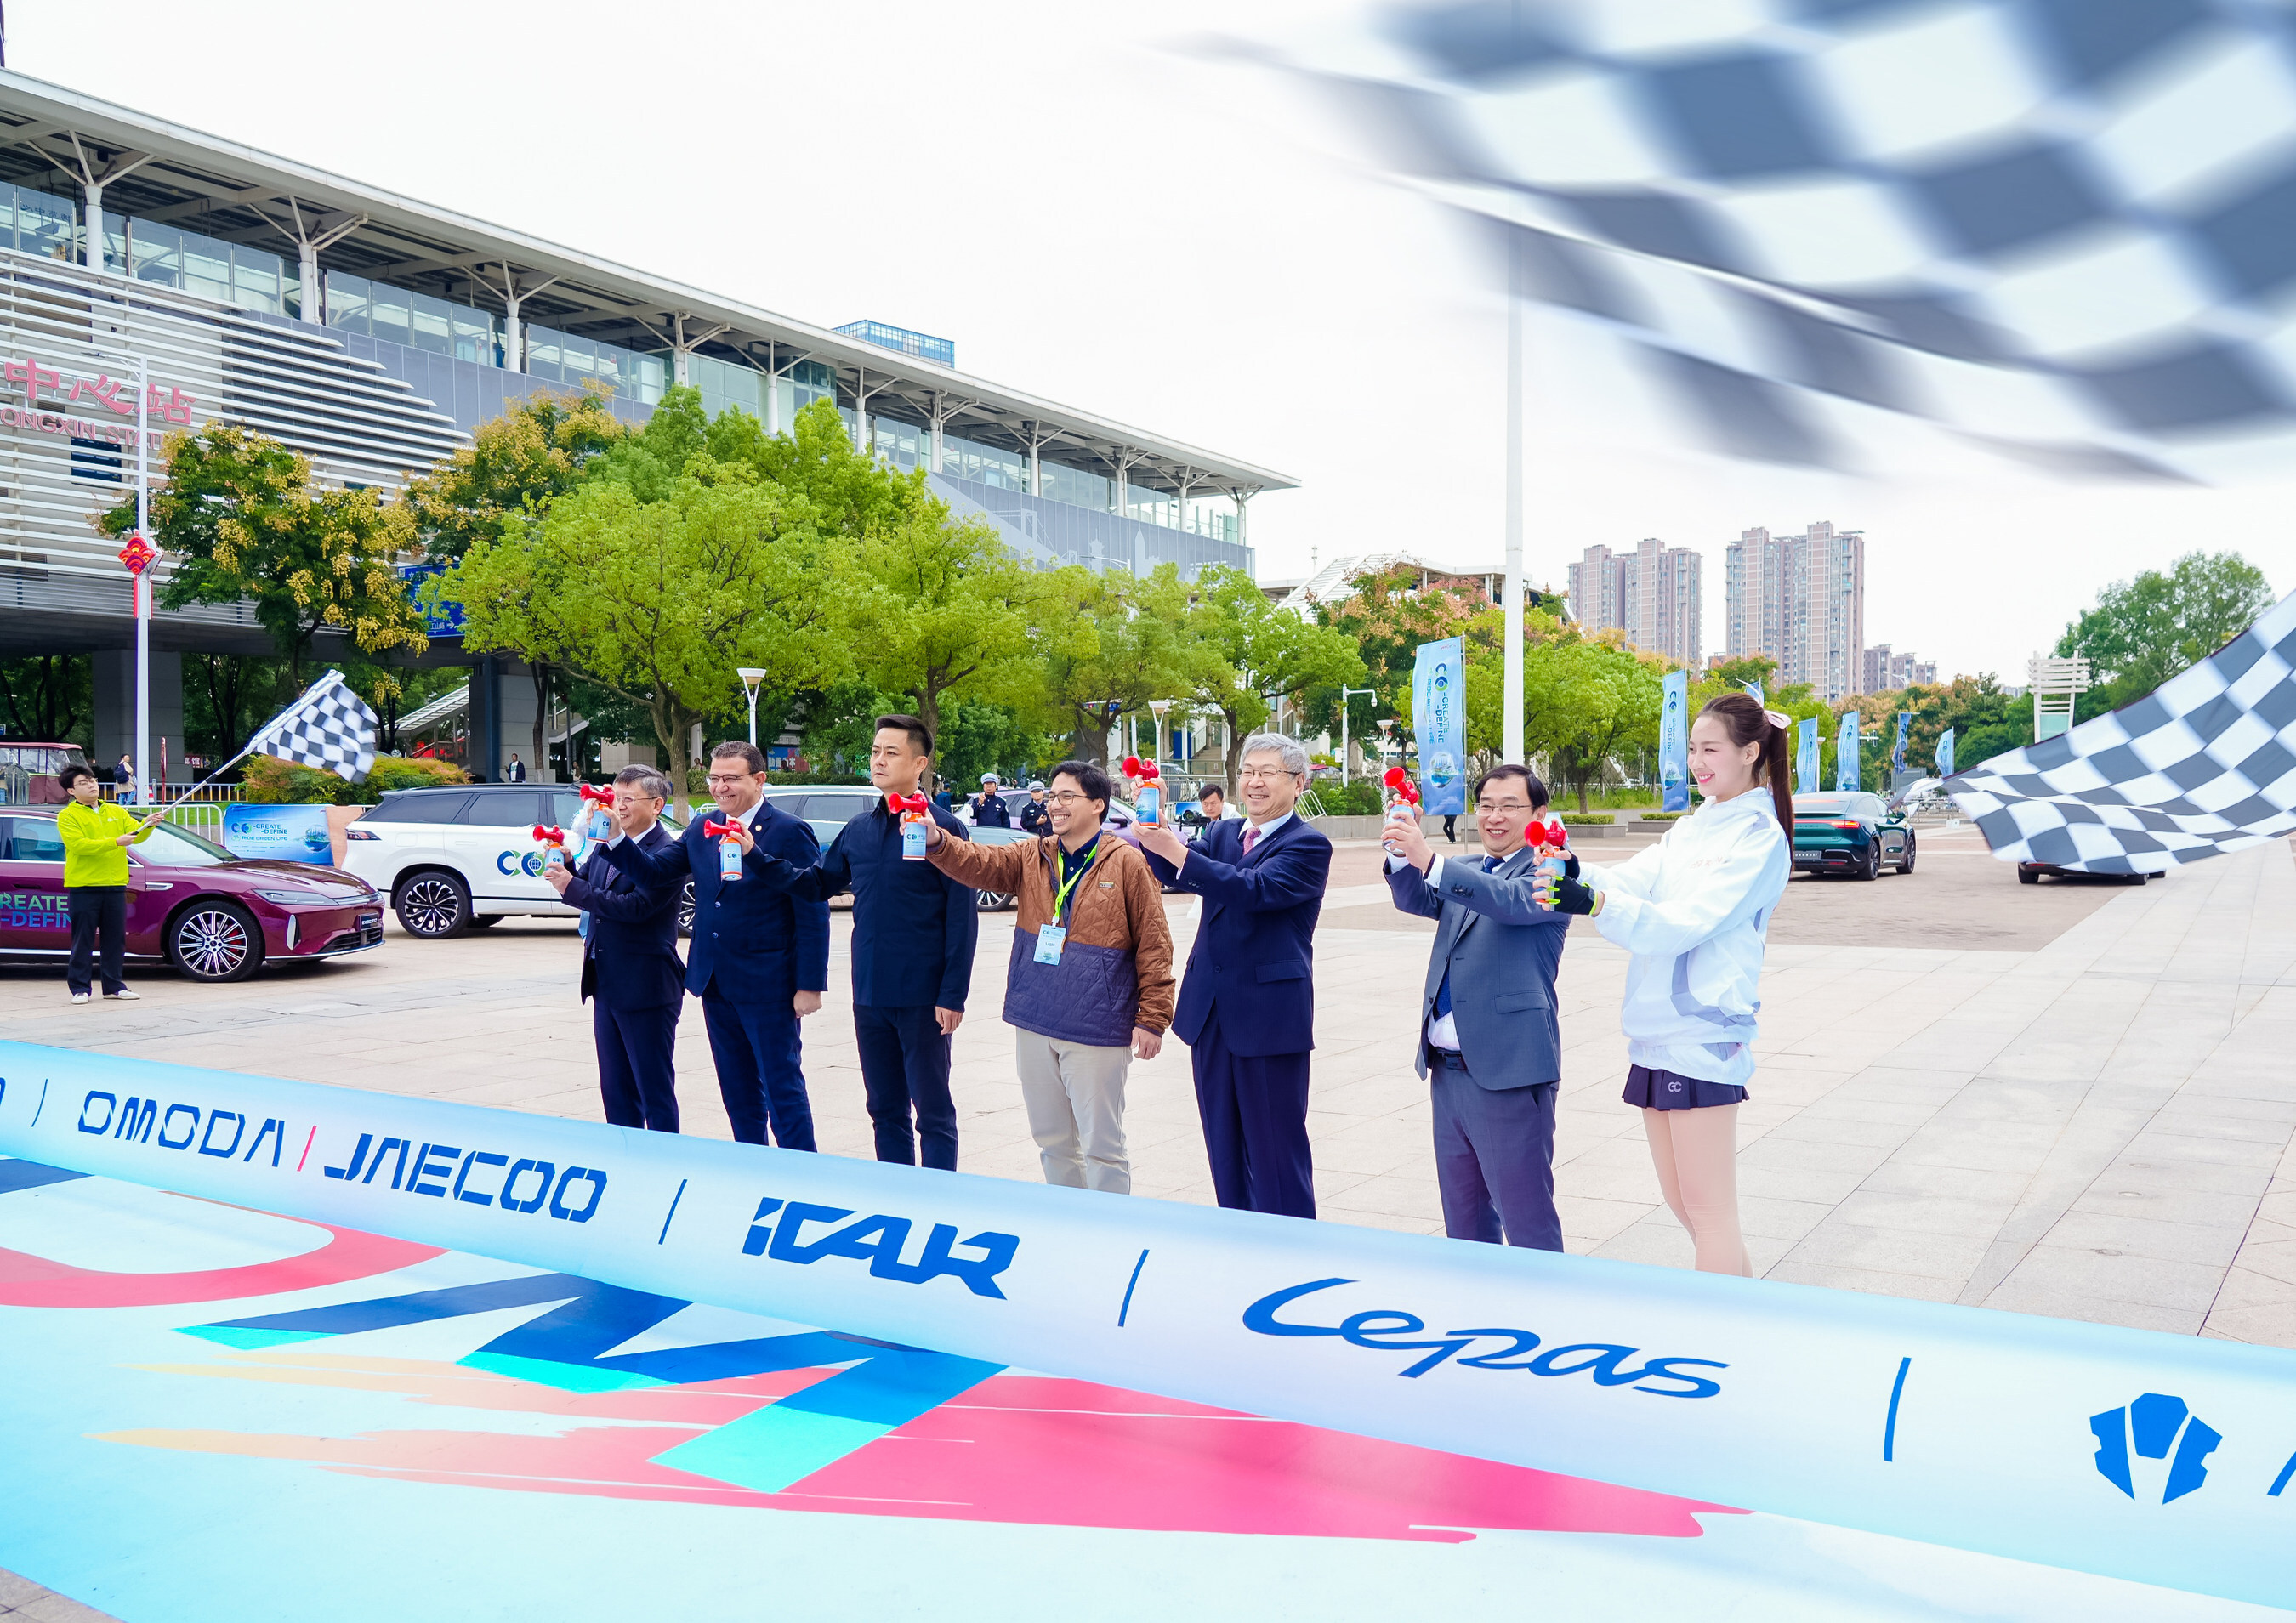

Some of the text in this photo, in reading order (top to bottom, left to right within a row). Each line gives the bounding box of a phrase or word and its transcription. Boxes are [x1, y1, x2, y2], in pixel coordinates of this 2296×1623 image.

[5, 358, 196, 424] 中心站
[78, 1090, 285, 1167] OMODA
[324, 1133, 608, 1223] JAECOO
